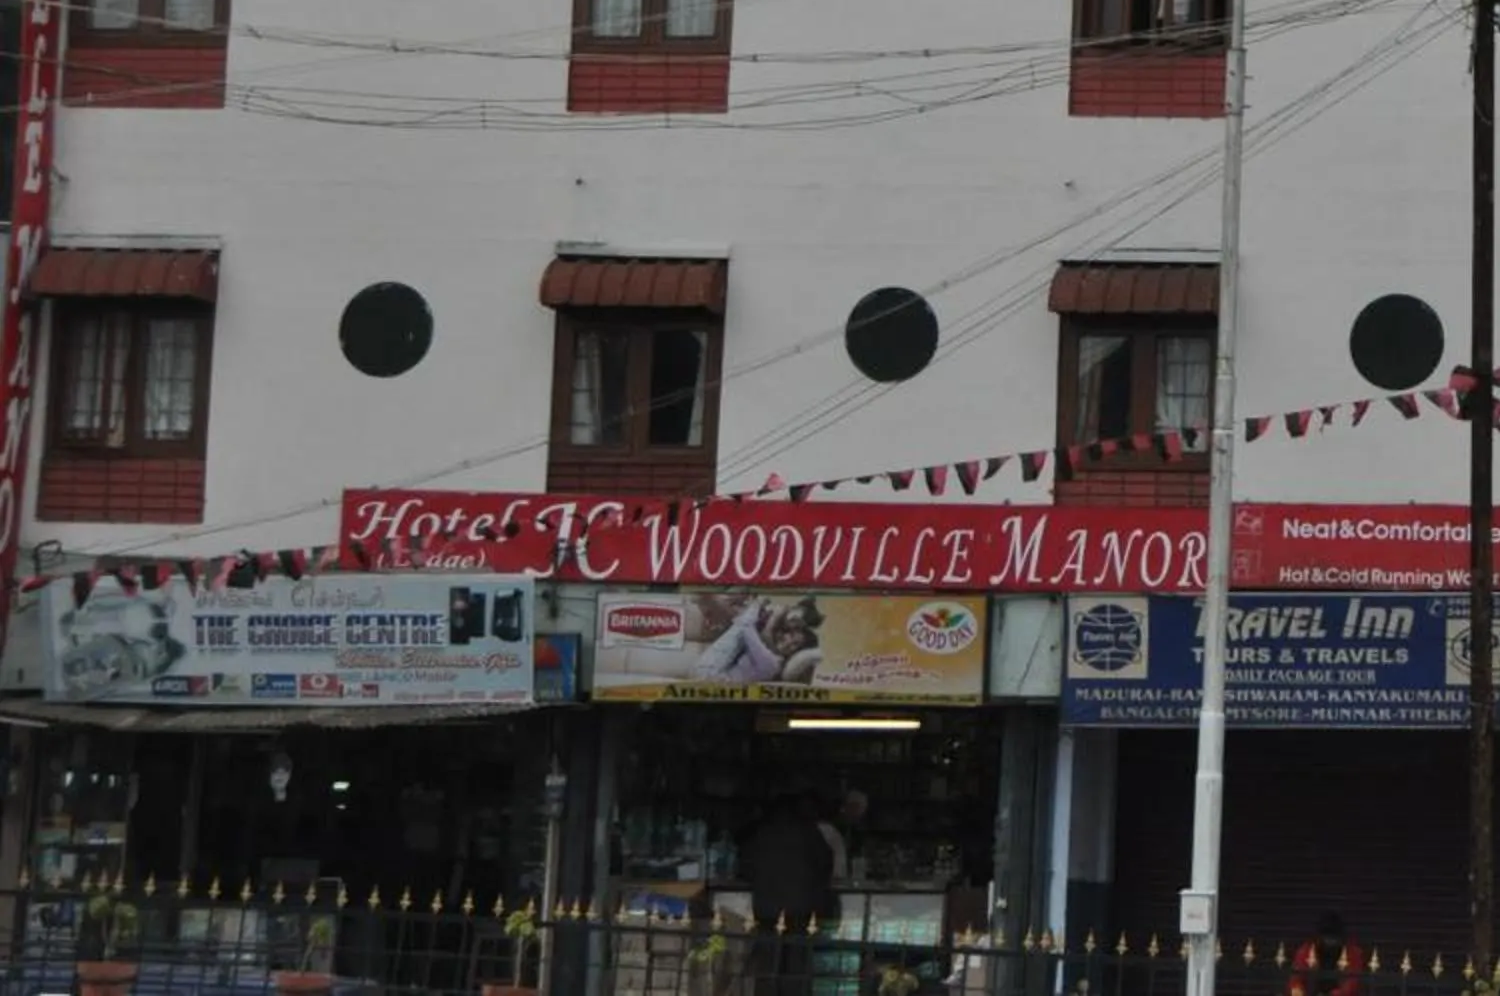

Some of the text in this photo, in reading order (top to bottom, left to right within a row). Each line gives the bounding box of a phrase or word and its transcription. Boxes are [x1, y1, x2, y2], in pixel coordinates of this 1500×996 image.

[350, 499, 530, 543] Hotel
[643, 503, 976, 582] WOODVILLE
[990, 512, 1211, 588] MANOR
[1371, 569, 1443, 588] Running
[1447, 571, 1500, 587] War
[192, 614, 445, 645] THE CHOICE CENTRE
[610, 612, 679, 630] BRITANNIA
[908, 621, 975, 650] GOOD DAY
[1191, 647, 1271, 664] TURS
[1303, 647, 1409, 664] TRAVELS
[662, 683, 749, 700] Ansari
[757, 684, 831, 701] Store
